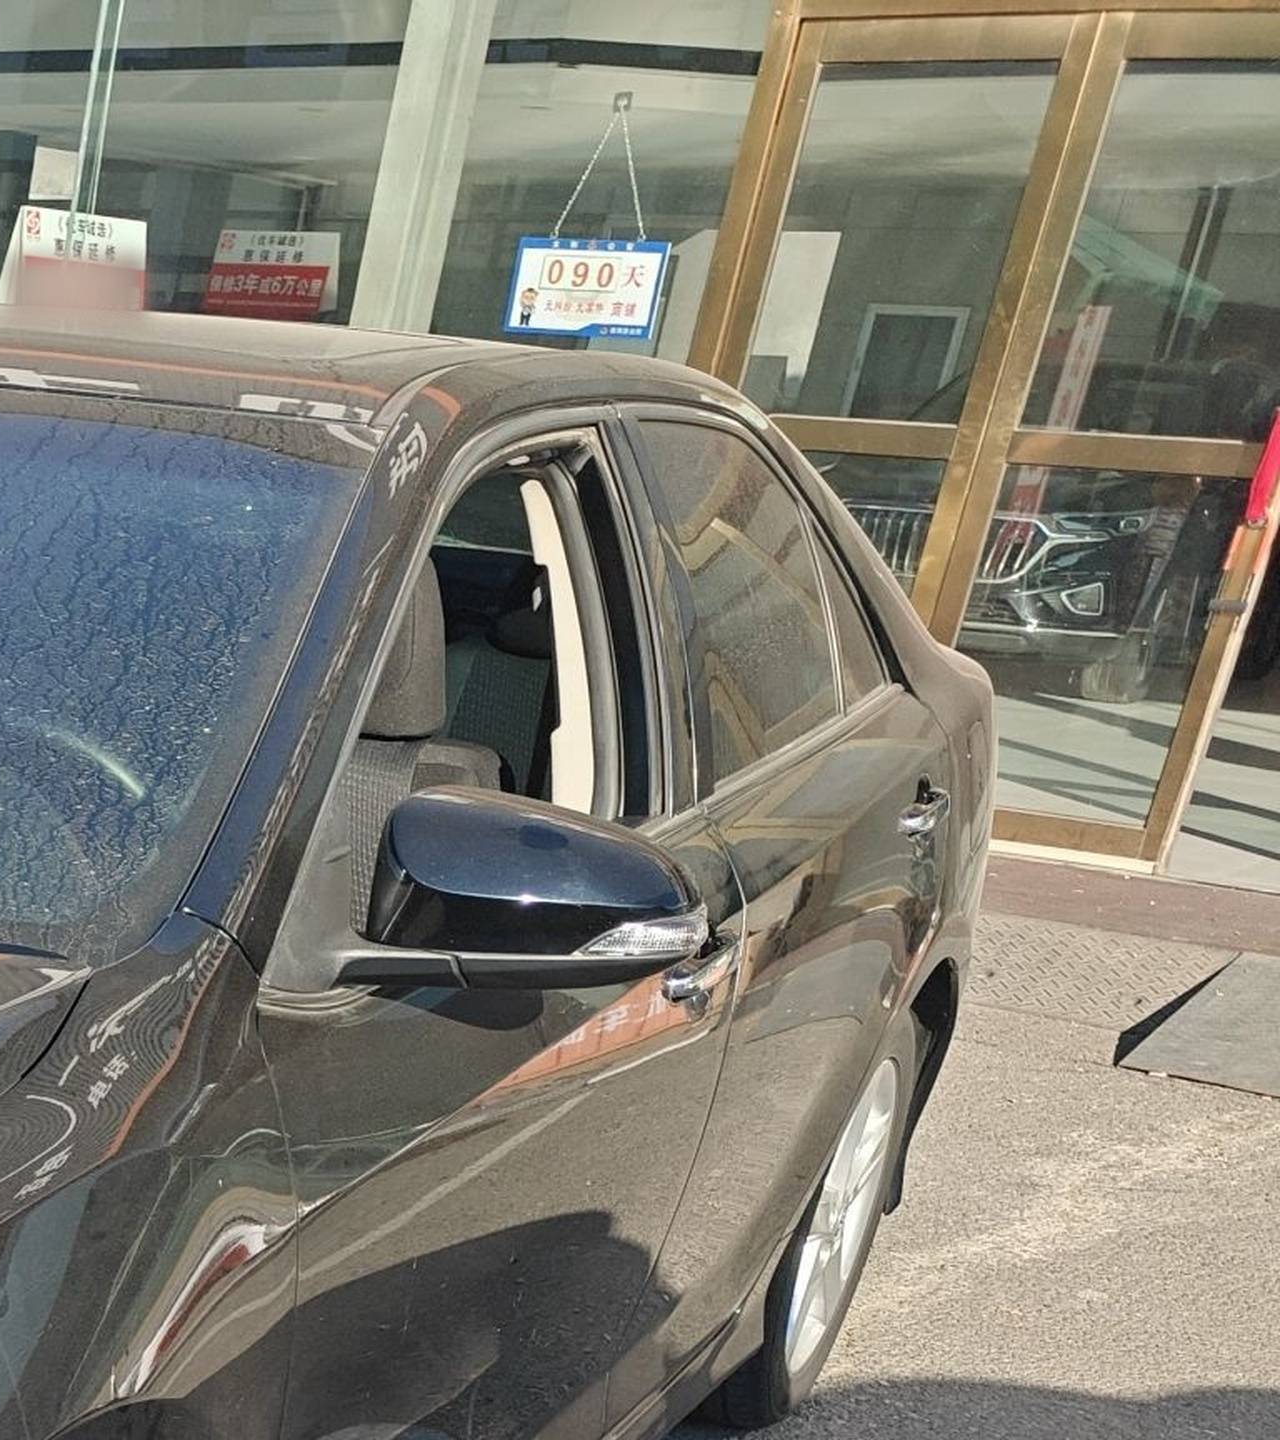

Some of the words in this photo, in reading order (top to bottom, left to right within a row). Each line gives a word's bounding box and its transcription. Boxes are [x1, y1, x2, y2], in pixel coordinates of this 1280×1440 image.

[209, 274, 322, 298] 保修3年或6万公里
